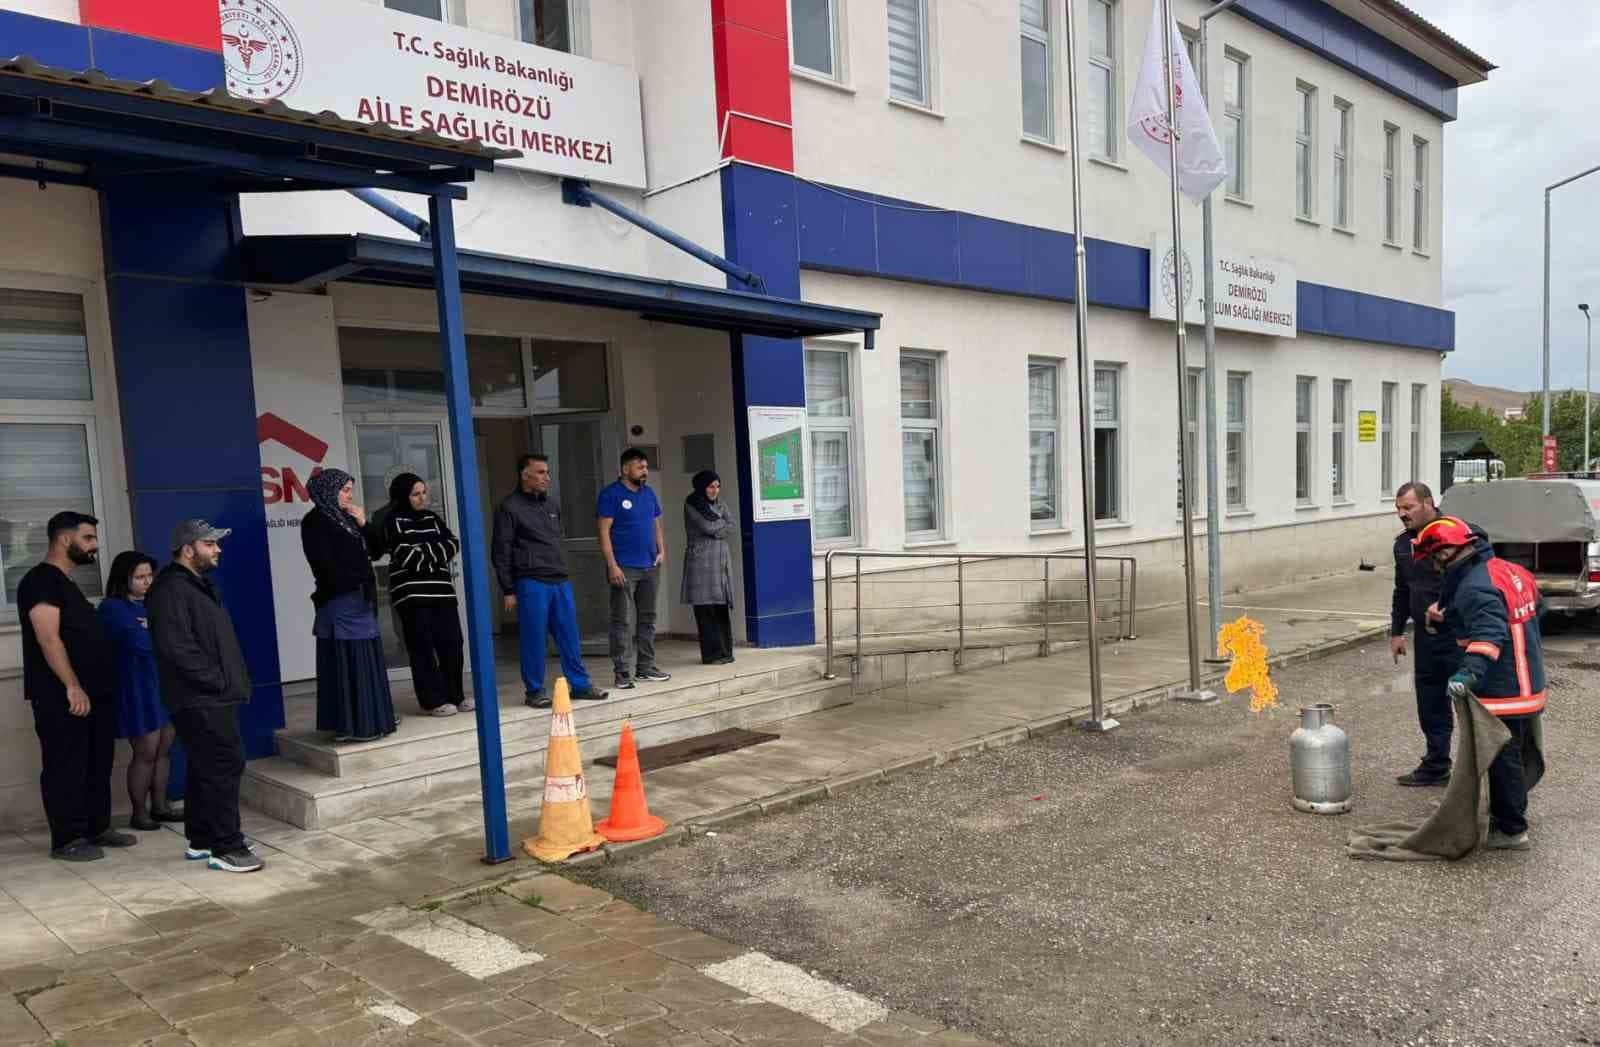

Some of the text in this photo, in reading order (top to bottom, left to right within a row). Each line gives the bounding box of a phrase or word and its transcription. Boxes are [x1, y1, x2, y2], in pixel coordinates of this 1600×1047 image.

[393, 31, 574, 92] T.C. Sağlık Bakanlığı
[426, 75, 551, 120] DEMİRÖZÜ
[357, 95, 613, 165] AİLE SAĞLIĞI MERKEZİ
[261, 466, 323, 504] SM
